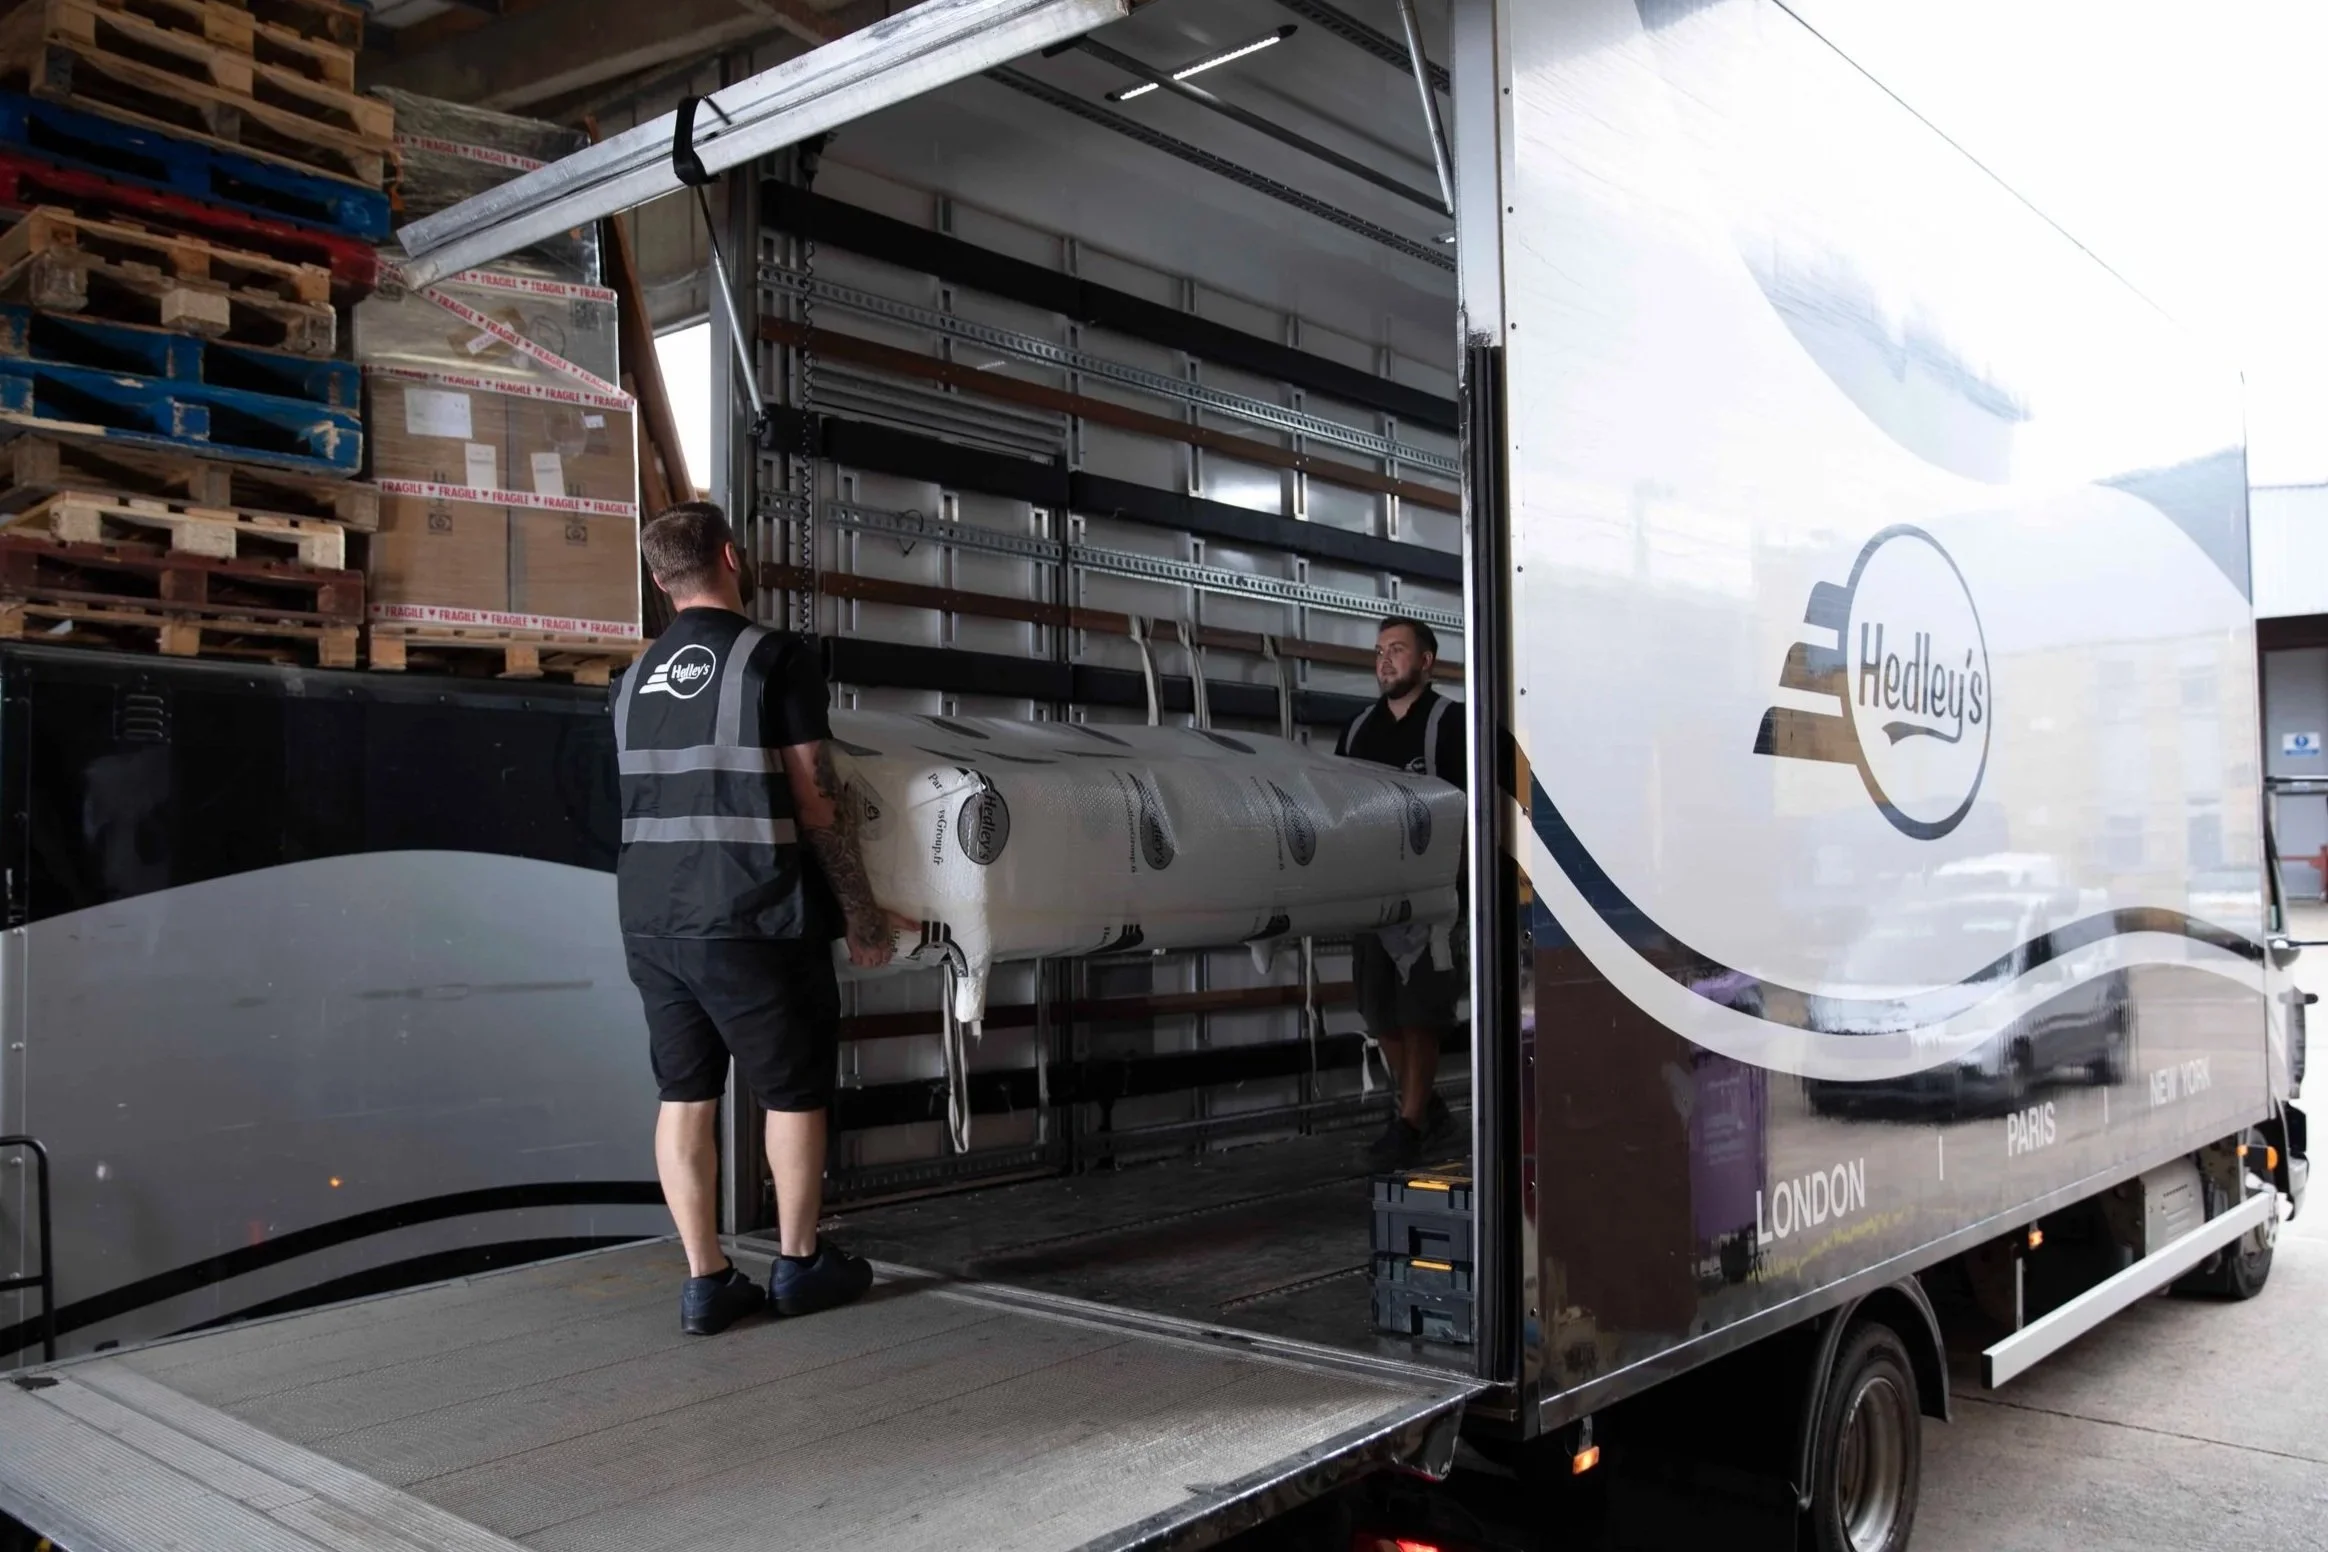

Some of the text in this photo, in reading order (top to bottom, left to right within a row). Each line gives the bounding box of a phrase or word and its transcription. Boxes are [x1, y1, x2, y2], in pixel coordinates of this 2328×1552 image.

[420, 138, 459, 155] FRAGILE
[472, 148, 508, 165] FRAGILE
[481, 273, 517, 288] FRAGILE
[531, 281, 567, 296] FRAGILE
[580, 287, 615, 301] FRAGILE
[438, 294, 474, 322] FRAGILE
[486, 320, 521, 347] FRAGILE
[533, 346, 568, 371] FRAGILE
[495, 380, 532, 396] FRAGILE
[546, 388, 581, 402] FRAGILE
[594, 395, 628, 410] FRAGILE
[382, 481, 629, 514] FRAGILE FRAGILE FRAGILE FRAGILE FRAGILE
[385, 606, 625, 635] FRAGILE FRAGILE FRAGILE FRAGILE FRAGILE
[1858, 622, 1983, 747] Hedley's
[978, 792, 998, 861] Hedley's
[1755, 1057, 2212, 1245] LONDON PARIS NEW YORK
